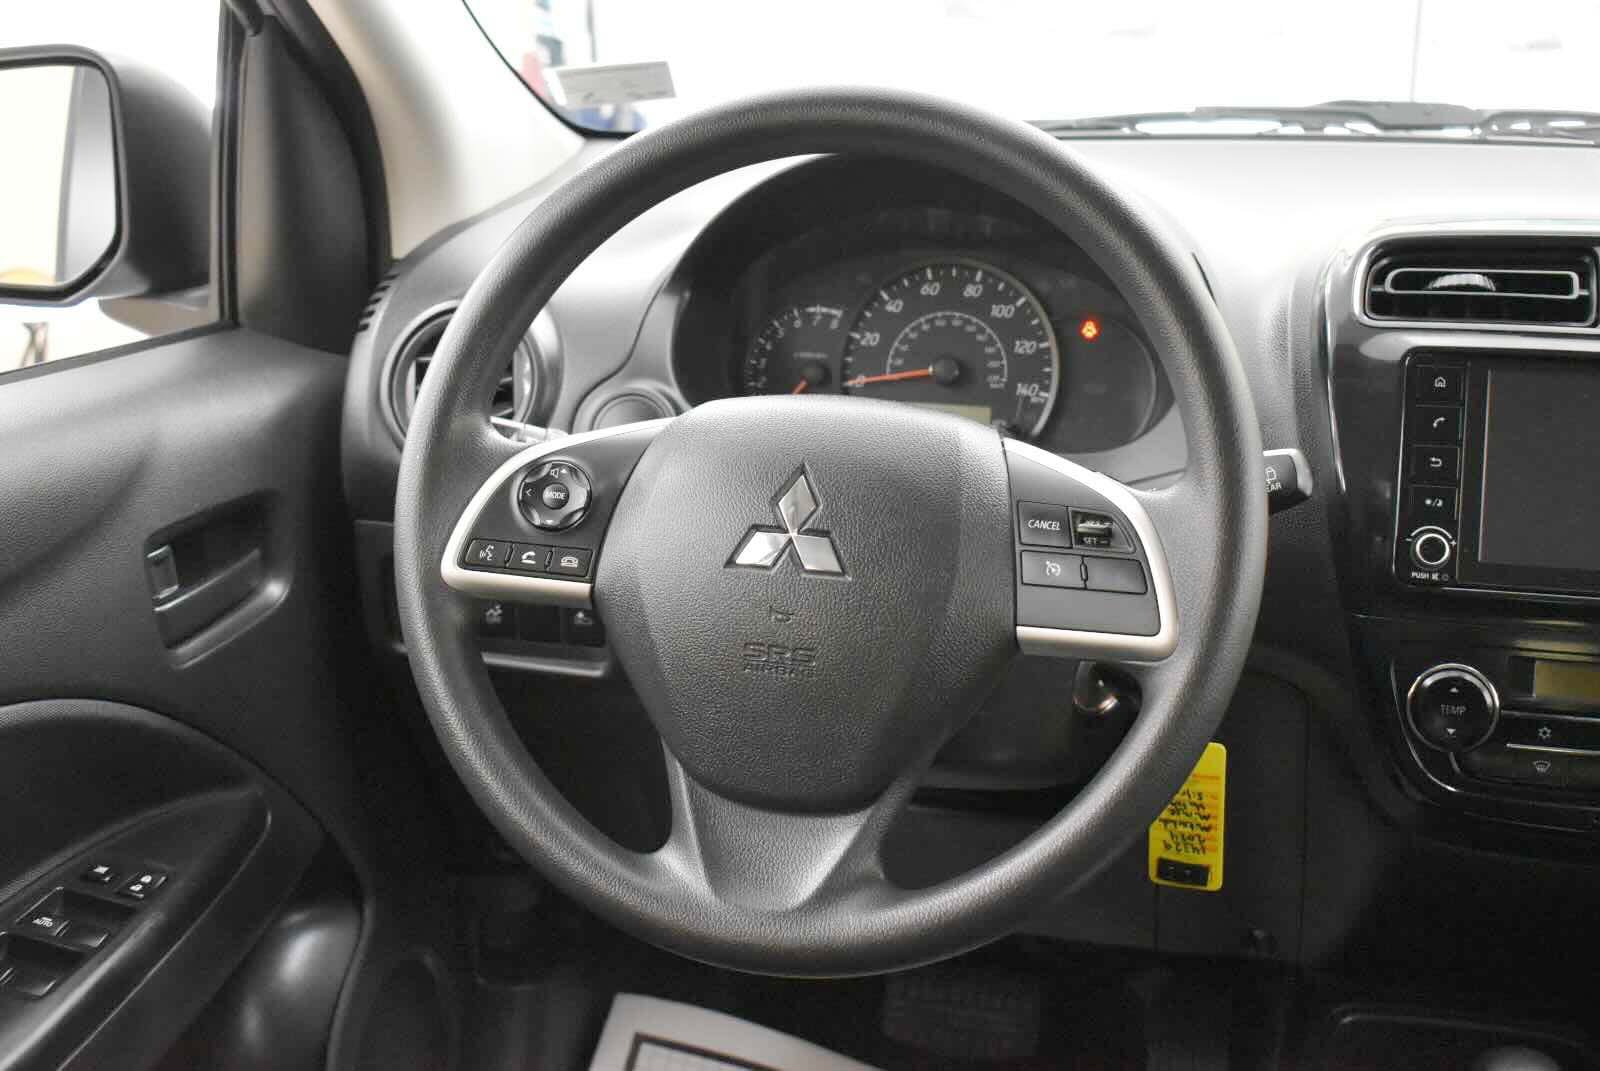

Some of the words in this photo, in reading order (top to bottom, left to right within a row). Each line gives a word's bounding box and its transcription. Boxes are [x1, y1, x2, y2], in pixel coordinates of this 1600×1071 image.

[920, 282, 940, 296] 60
[963, 283, 983, 297] 80
[885, 299, 904, 313] 40
[990, 304, 1015, 318] 100
[860, 332, 880, 346] 20
[1014, 340, 1037, 354] 120
[1015, 382, 1039, 397] 140
[1027, 519, 1061, 531] CANCEL
[1411, 571, 1430, 580] PUSH
[1440, 703, 1467, 718] TEMP
